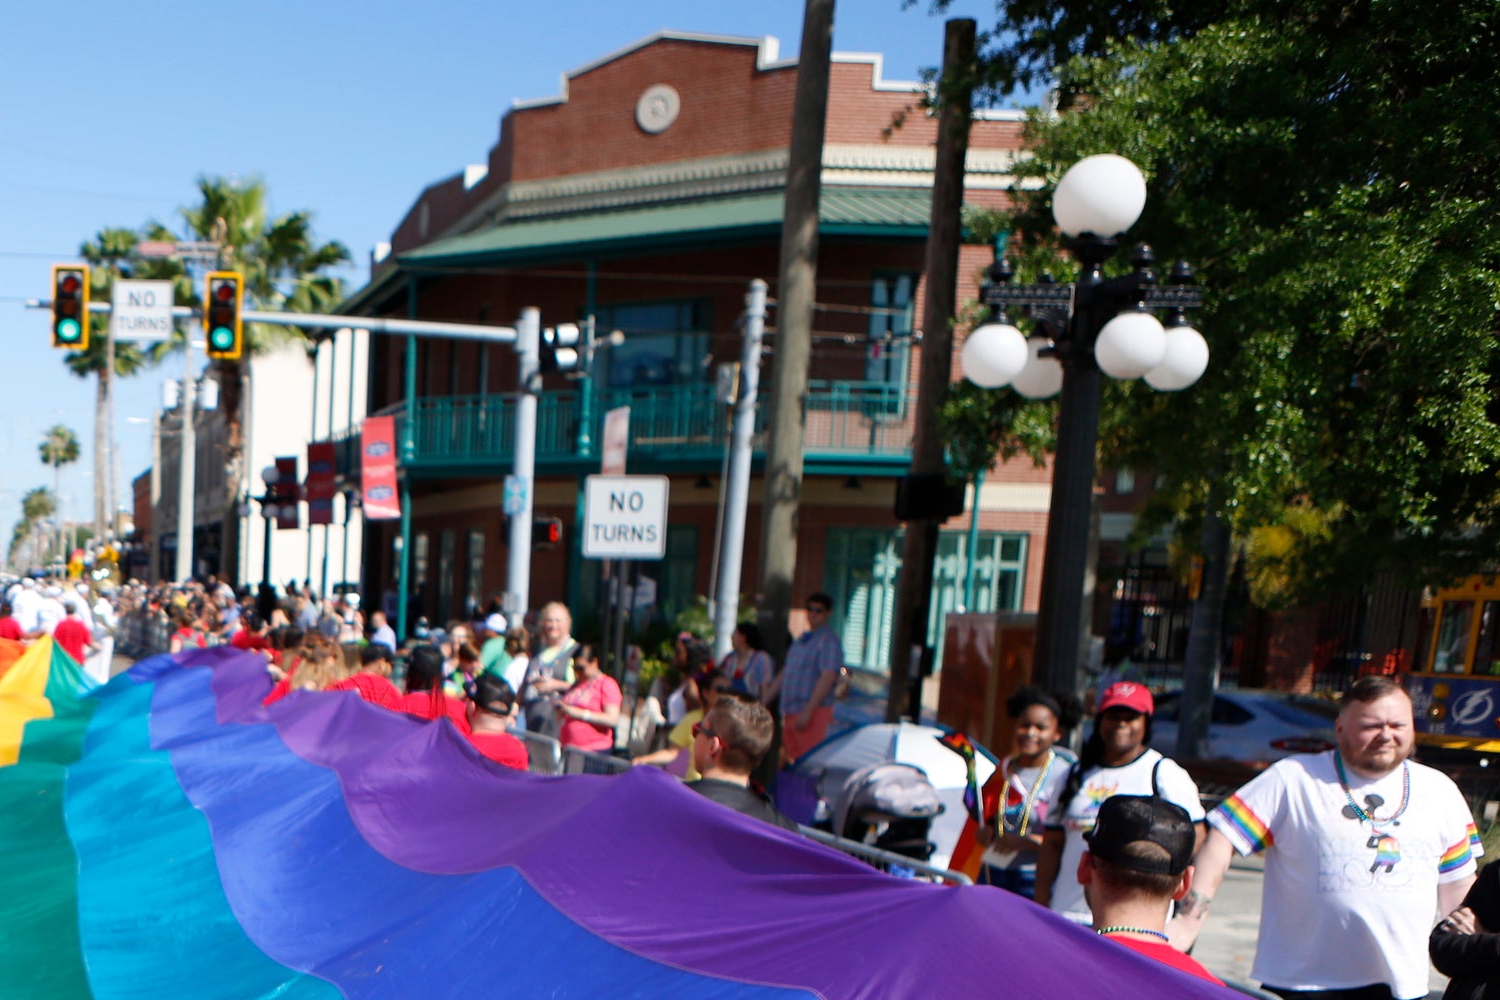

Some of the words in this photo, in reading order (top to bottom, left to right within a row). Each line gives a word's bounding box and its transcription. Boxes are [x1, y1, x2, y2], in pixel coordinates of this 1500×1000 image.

[128, 290, 156, 308] NO
[117, 315, 168, 331] TURNS
[609, 491, 644, 513] NO
[592, 523, 658, 543] TURNS
